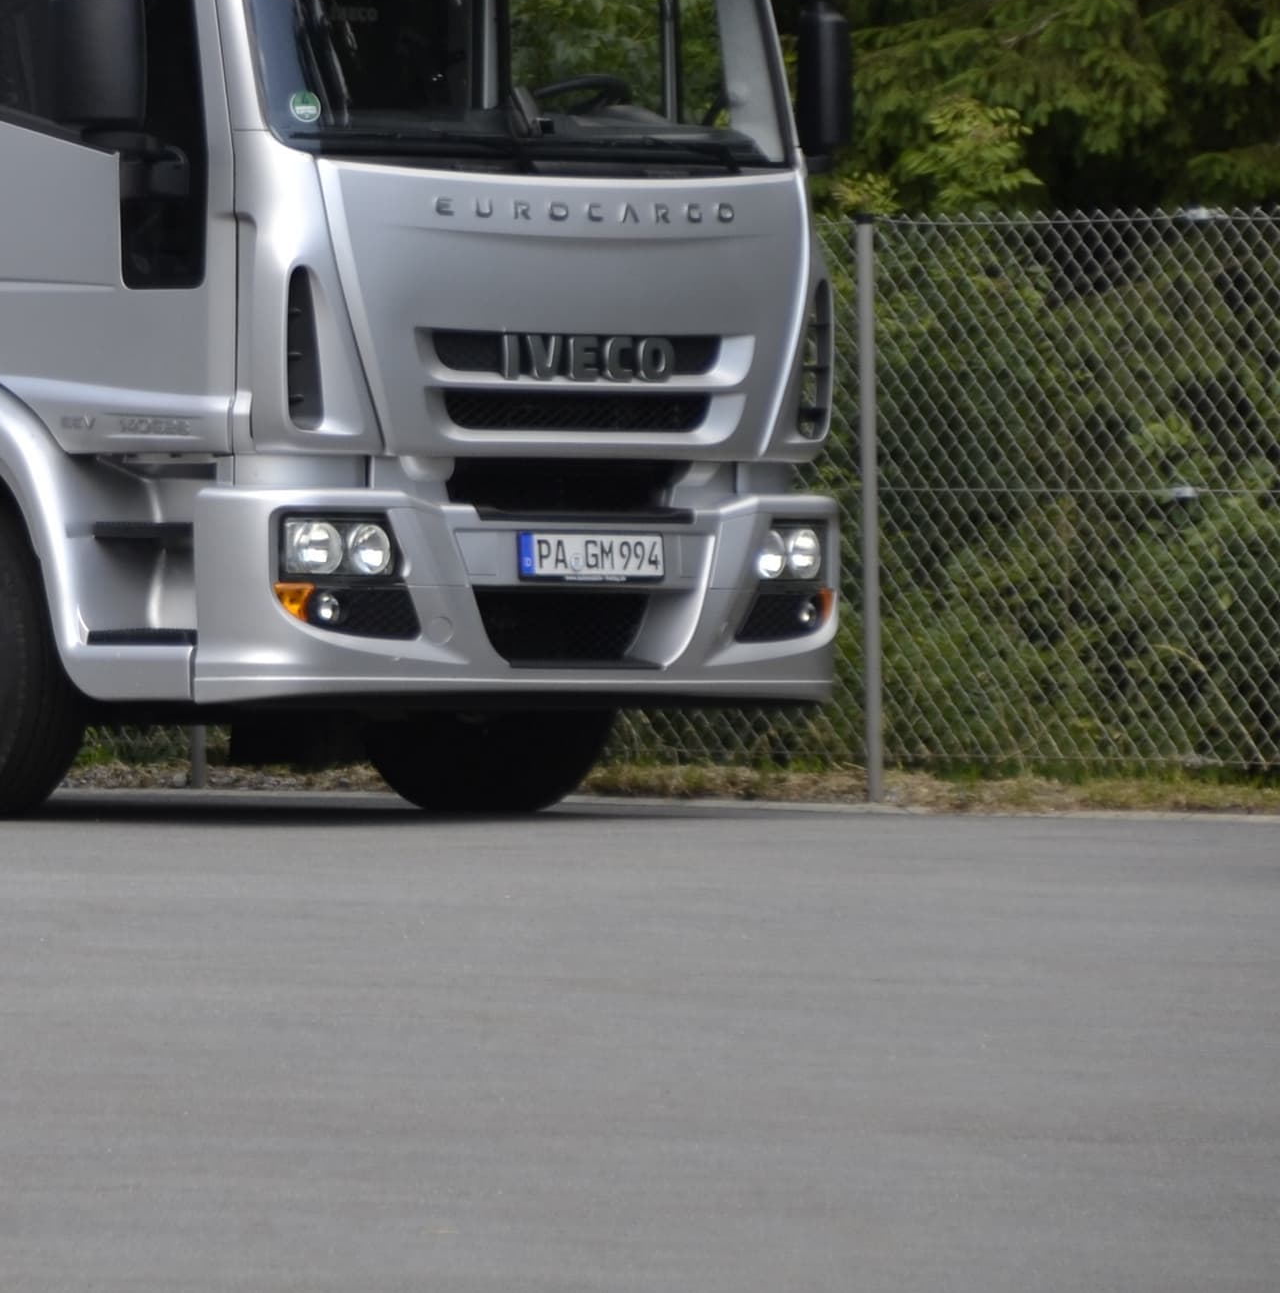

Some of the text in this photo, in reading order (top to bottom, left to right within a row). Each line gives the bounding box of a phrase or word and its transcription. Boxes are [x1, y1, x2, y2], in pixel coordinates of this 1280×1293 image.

[434, 196, 736, 223] EUROCARGO
[500, 332, 676, 383] IVECO
[537, 539, 567, 569] PA
